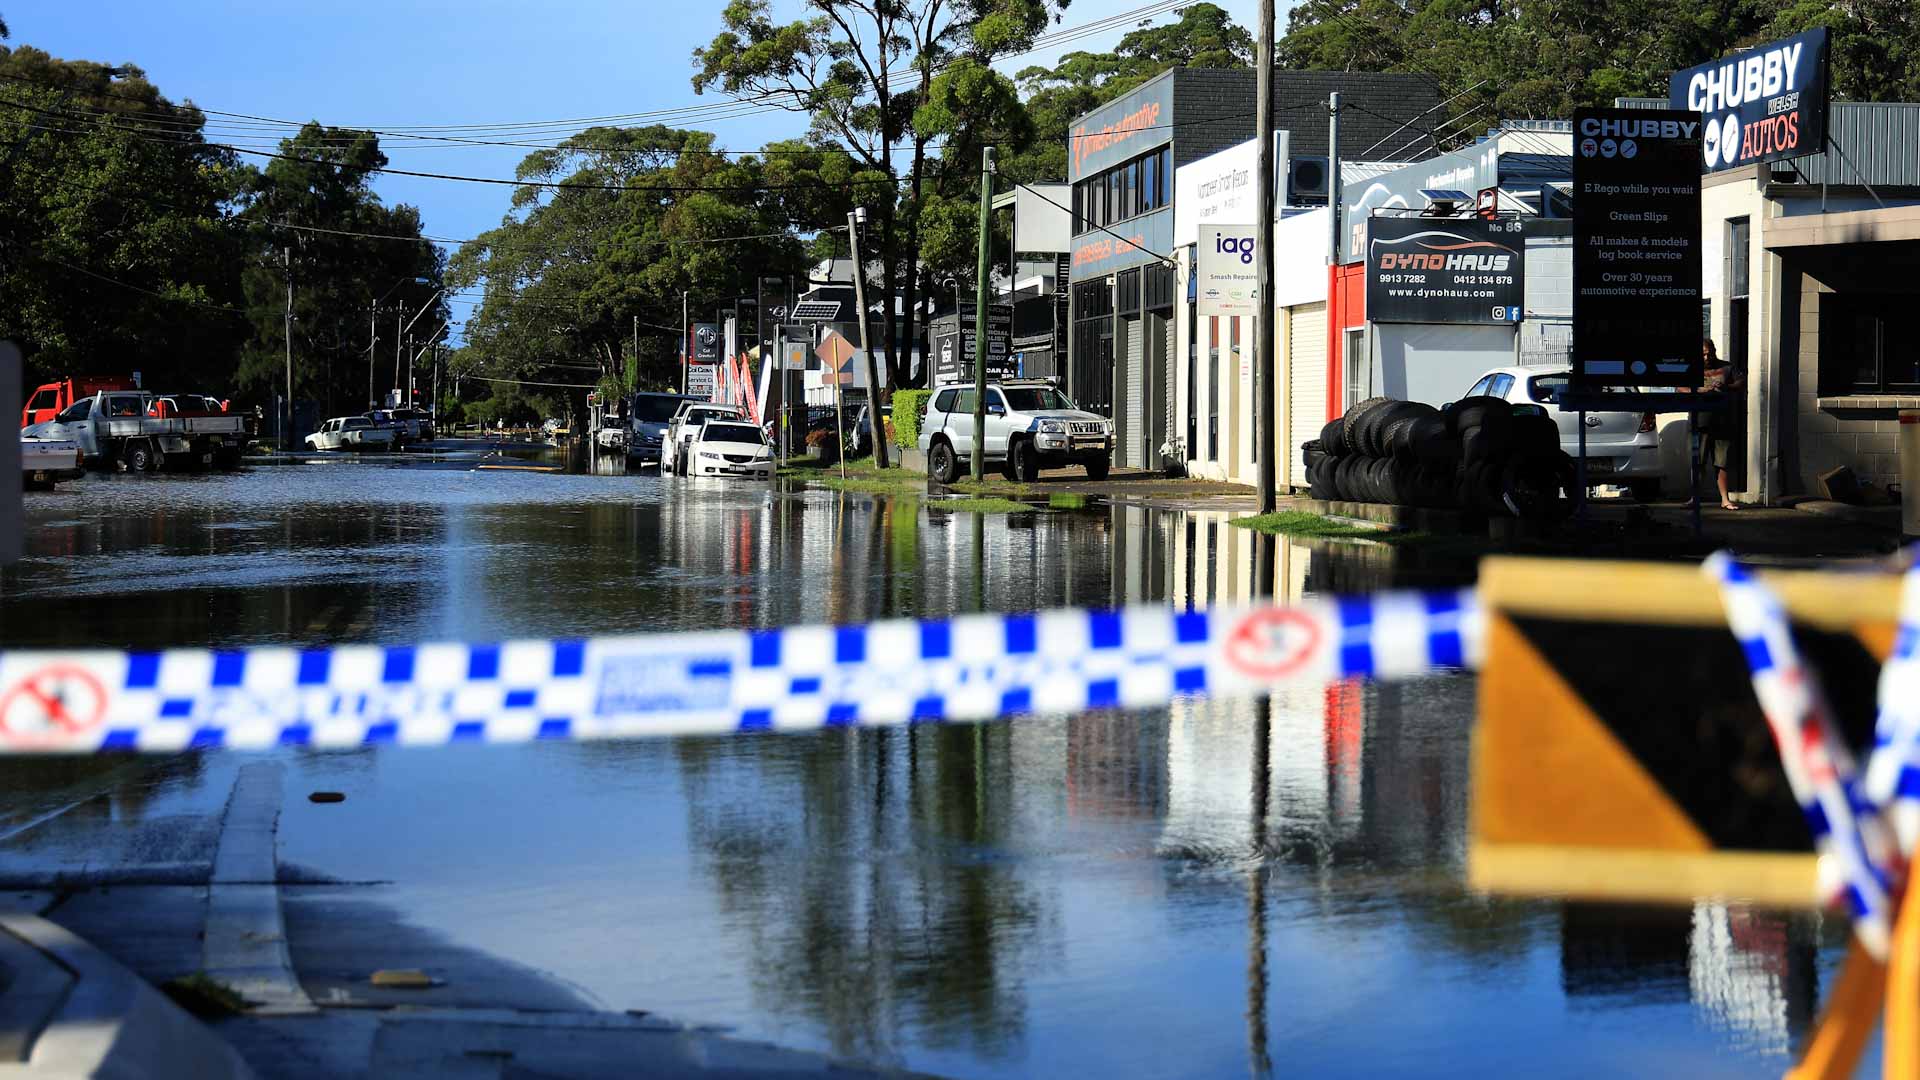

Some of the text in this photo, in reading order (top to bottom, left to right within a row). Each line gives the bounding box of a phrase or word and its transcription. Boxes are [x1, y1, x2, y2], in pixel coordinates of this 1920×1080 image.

[1688, 42, 1802, 113] CHUBBY
[1768, 91, 1799, 115] WELSH
[1580, 119, 1698, 139] CHUBBY
[1740, 111, 1799, 160] AUTOS
[1584, 184, 1694, 196] E Rego while you wait
[1609, 211, 1668, 223] Green Slips
[1489, 222, 1522, 233] No 86
[1590, 236, 1688, 247] All makes & models
[1216, 232, 1255, 264] iag
[1598, 250, 1682, 261] log book service
[1380, 254, 1511, 271] DYNOHAUS
[1379, 275, 1426, 283] 9913 7282
[1454, 276, 1513, 285] 0412 134 878
[1602, 272, 1673, 284] Over 30 years
[1388, 289, 1495, 298] www.dynohaus.com
[1580, 286, 1697, 298] automotive experience
